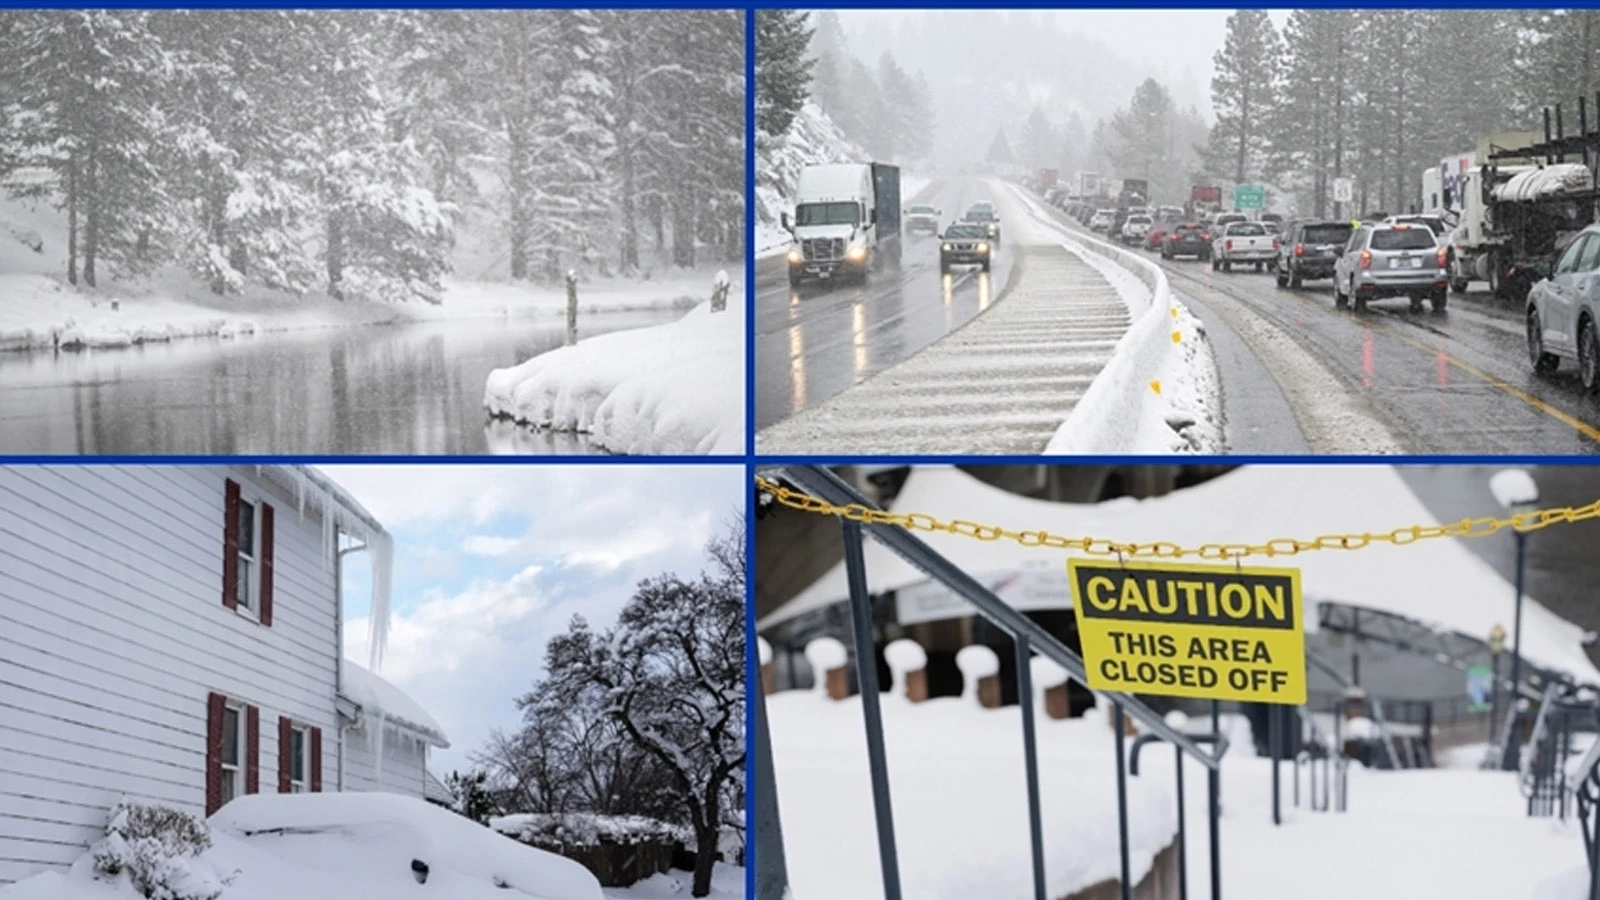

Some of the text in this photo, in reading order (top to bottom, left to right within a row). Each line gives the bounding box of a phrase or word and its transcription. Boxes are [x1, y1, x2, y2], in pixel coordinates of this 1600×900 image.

[1086, 576, 1285, 620] CAUTION
[1107, 631, 1272, 664] THIS AREA
[1100, 659, 1288, 692] CLOSED OFF
